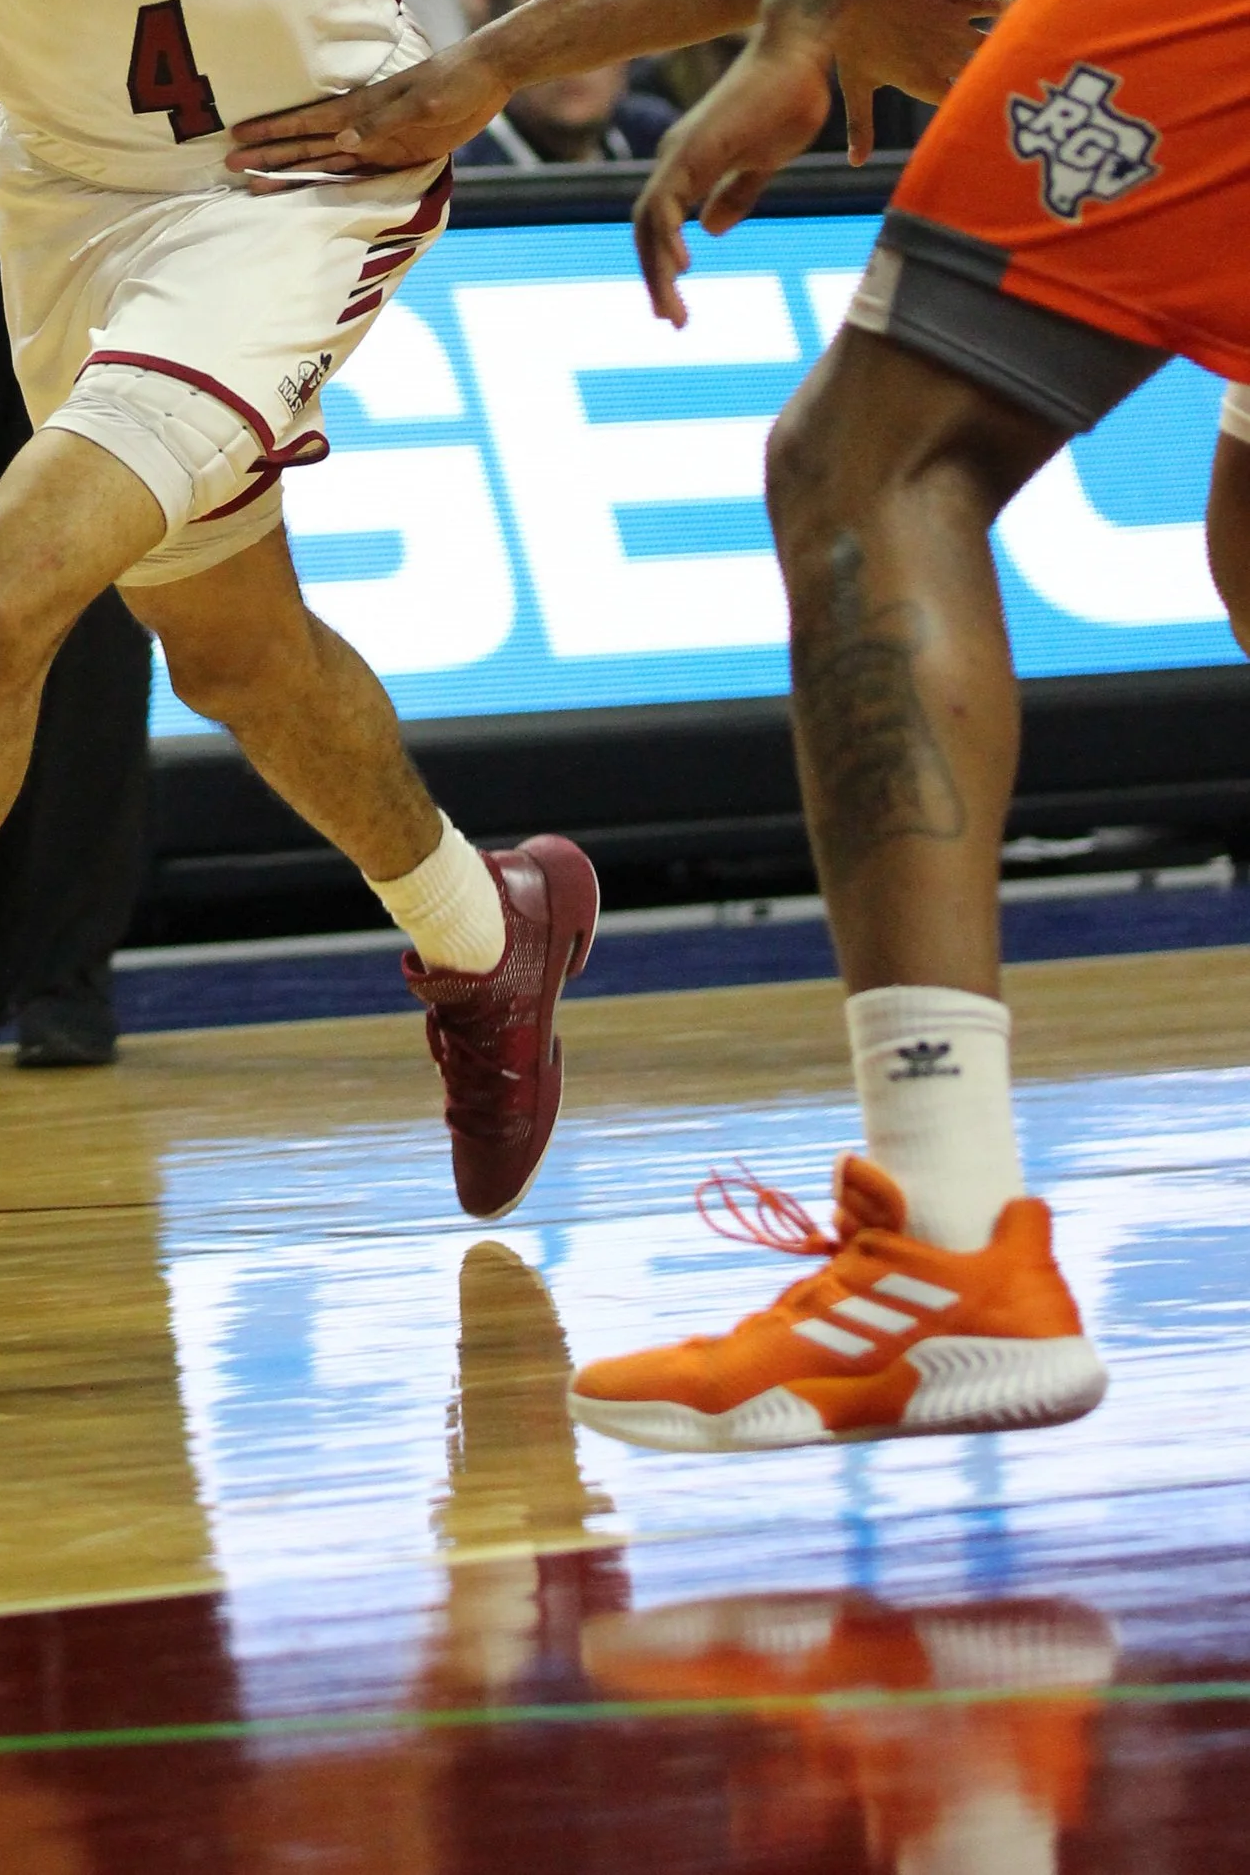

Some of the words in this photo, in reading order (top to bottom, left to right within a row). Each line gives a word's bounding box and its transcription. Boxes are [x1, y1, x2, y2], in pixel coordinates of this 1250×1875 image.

[1028, 87, 1159, 202] RGV
[277, 375, 305, 420] NMS
[152, 261, 1230, 681] GE
